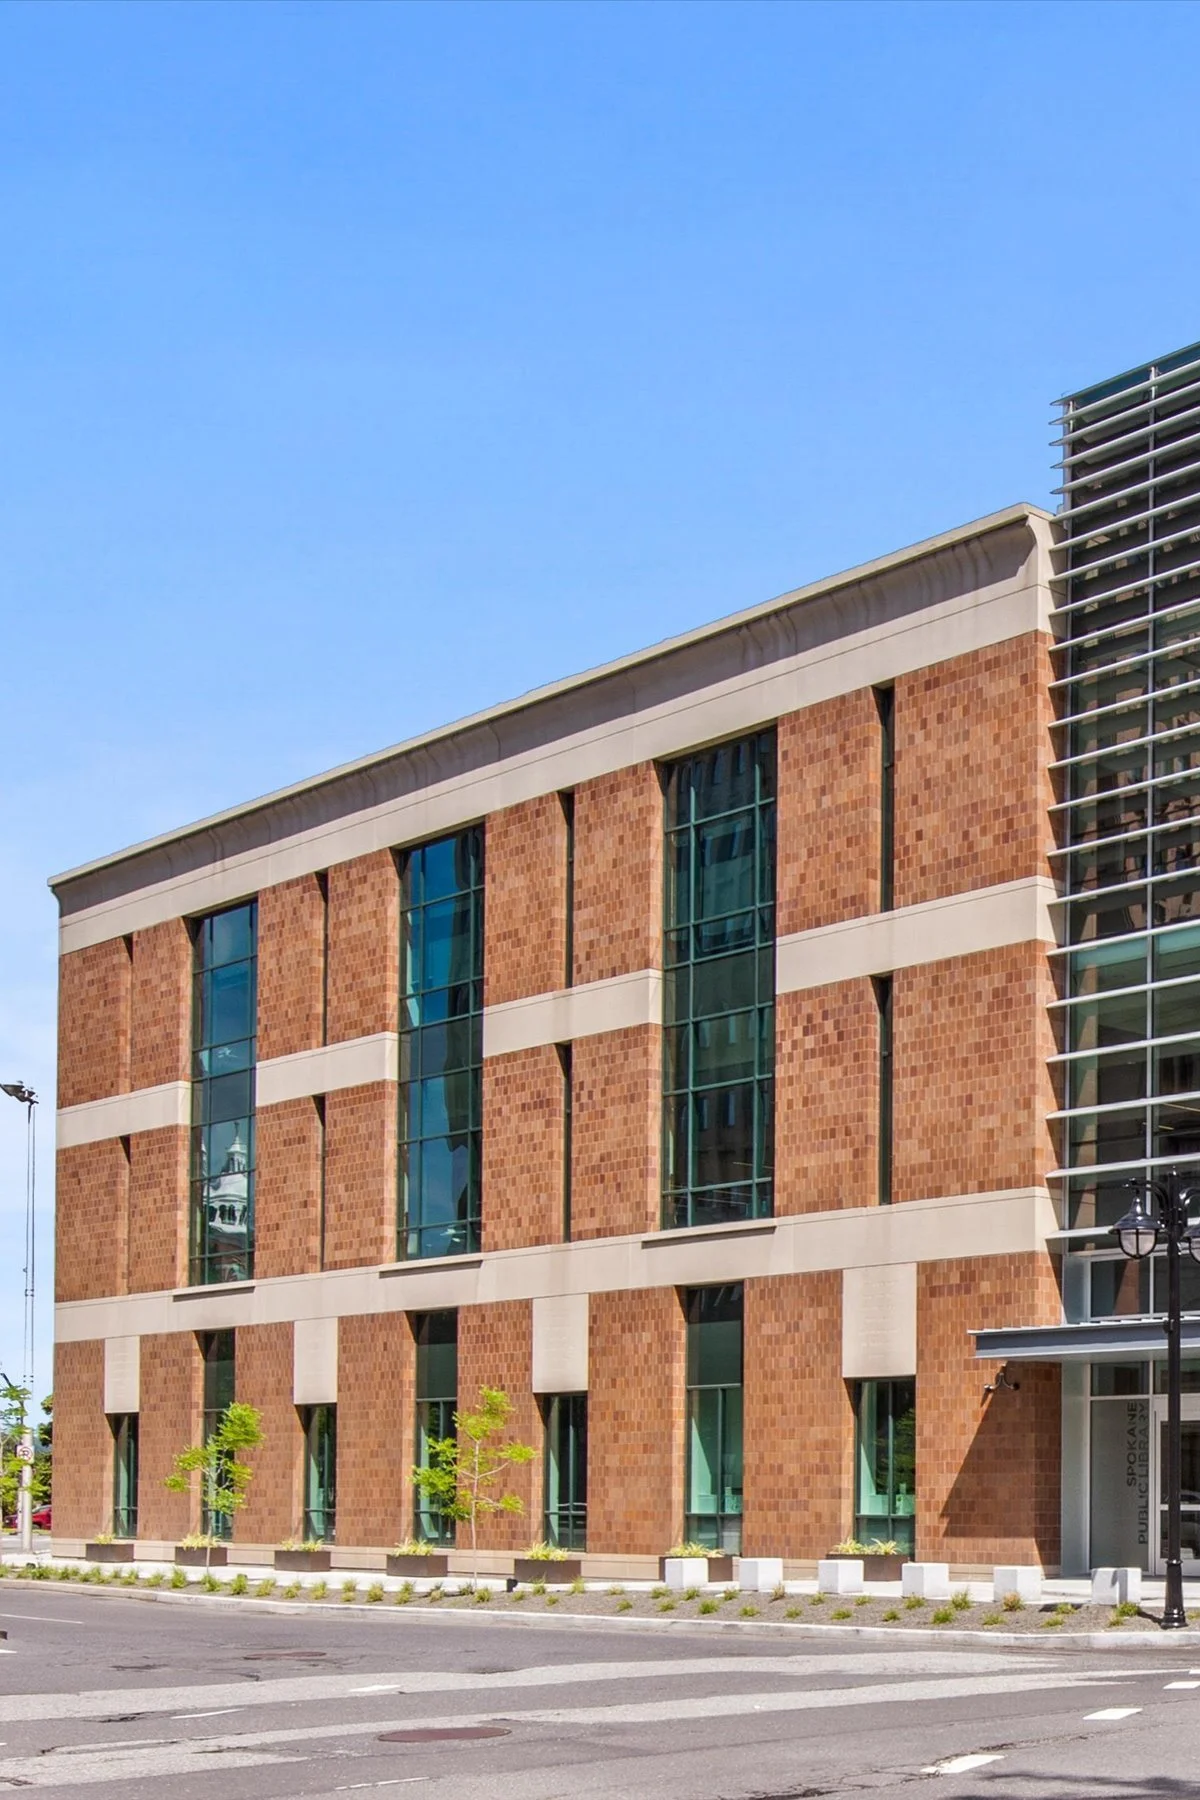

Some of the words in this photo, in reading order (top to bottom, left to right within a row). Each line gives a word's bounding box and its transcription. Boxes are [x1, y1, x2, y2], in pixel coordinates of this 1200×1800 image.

[1126, 1401, 1138, 1487] SPOKANE
[1138, 1403, 1149, 1478] LIBRARY
[1138, 1482, 1149, 1545] PUBLIC
